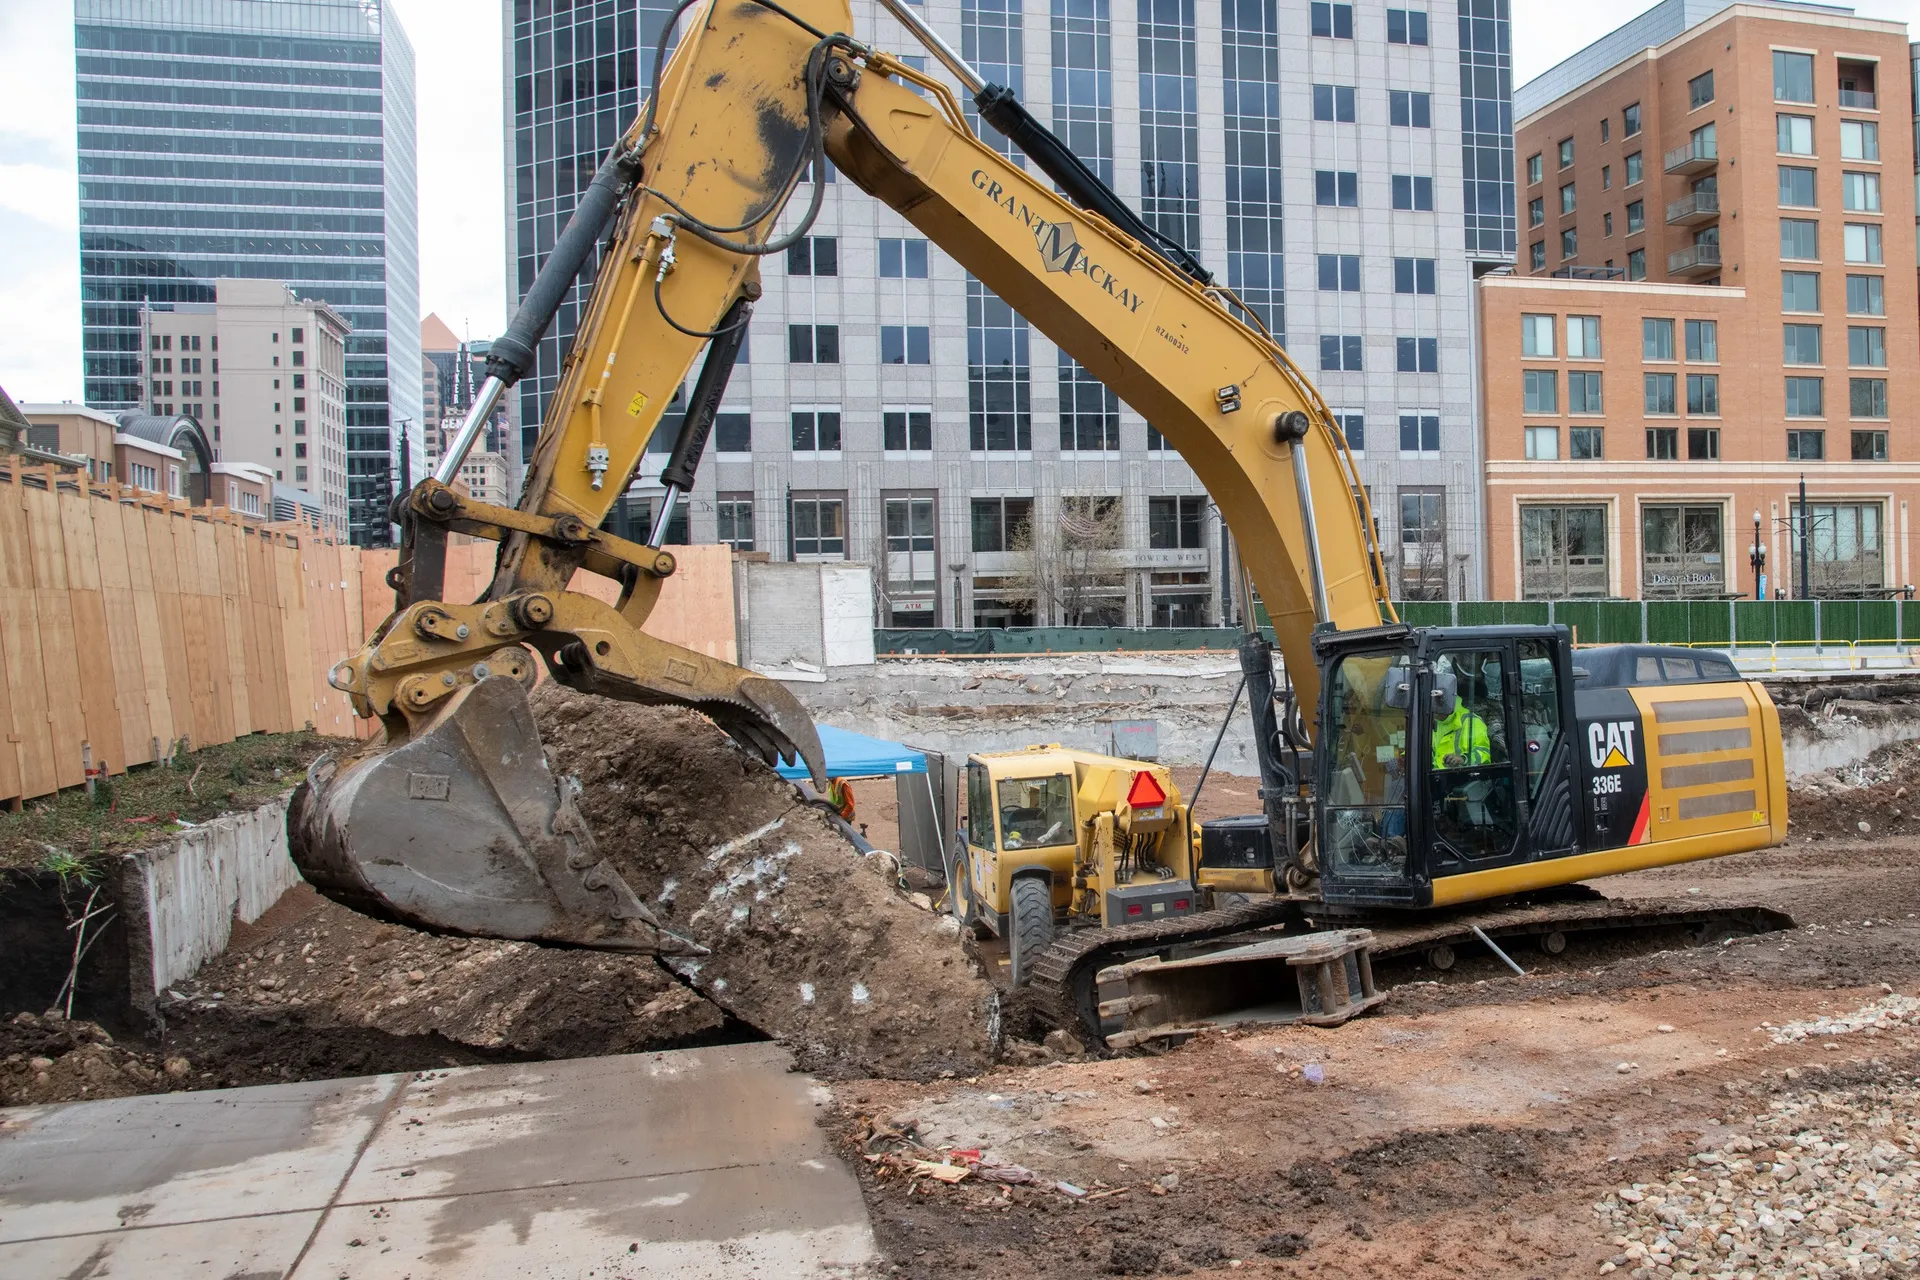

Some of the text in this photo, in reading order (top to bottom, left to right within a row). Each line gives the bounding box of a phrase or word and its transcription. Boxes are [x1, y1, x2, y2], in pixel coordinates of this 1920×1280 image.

[971, 169, 1145, 314] GRANT MACKAY
[1134, 554, 1169, 562] TOWER
[1177, 553, 1203, 561] WEST
[1692, 572, 1716, 583] Book
[1588, 721, 1635, 769] CAT
[1592, 774, 1622, 795] 336E
